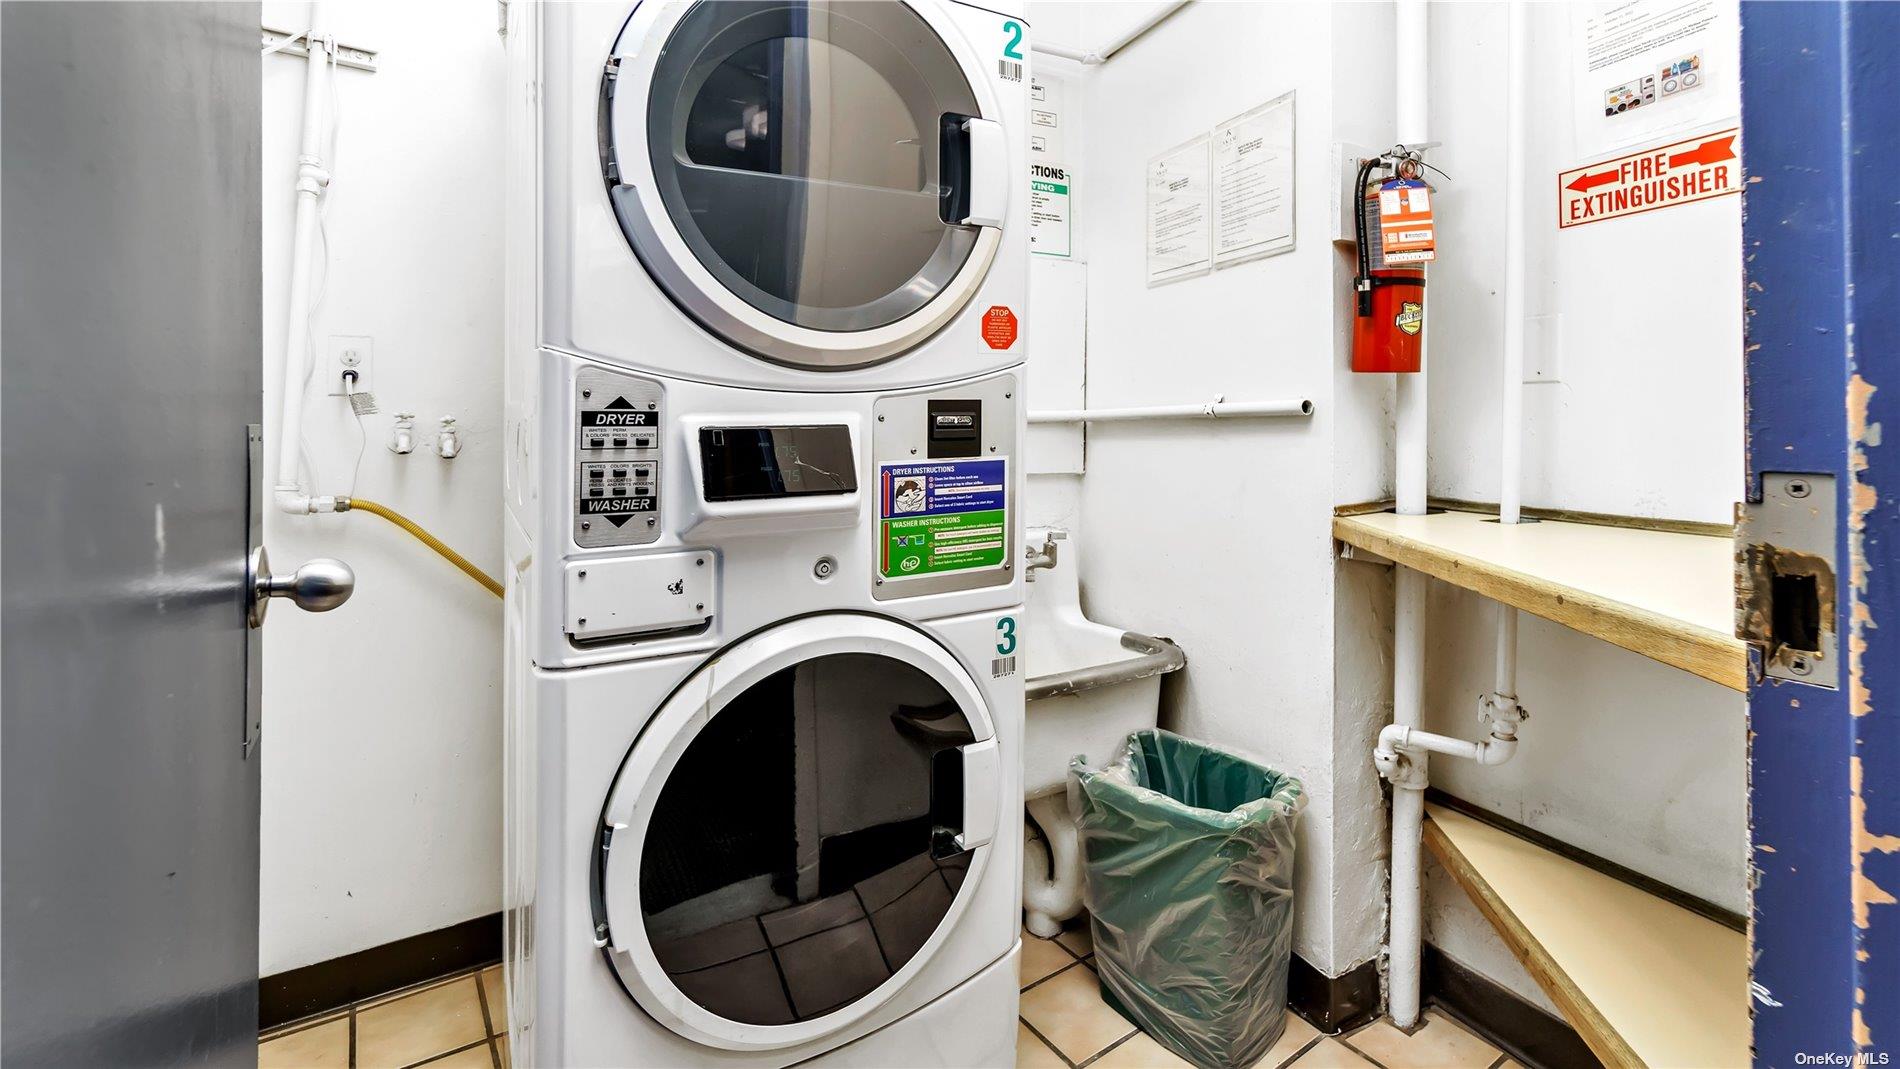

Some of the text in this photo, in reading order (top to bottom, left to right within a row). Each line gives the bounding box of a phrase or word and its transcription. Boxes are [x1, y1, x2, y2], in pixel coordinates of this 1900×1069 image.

[1003, 20, 1023, 60] 2
[1620, 153, 1667, 184] FIRE
[1570, 165, 1728, 220] EXTINGUISHER
[595, 413, 646, 425] DRYER
[892, 465, 955, 476] DRYER INSTRUCTIONS
[588, 499, 650, 512] WASHER
[892, 516, 961, 528] WASHER INSTRUCTIONS
[996, 616, 1016, 655] 3
